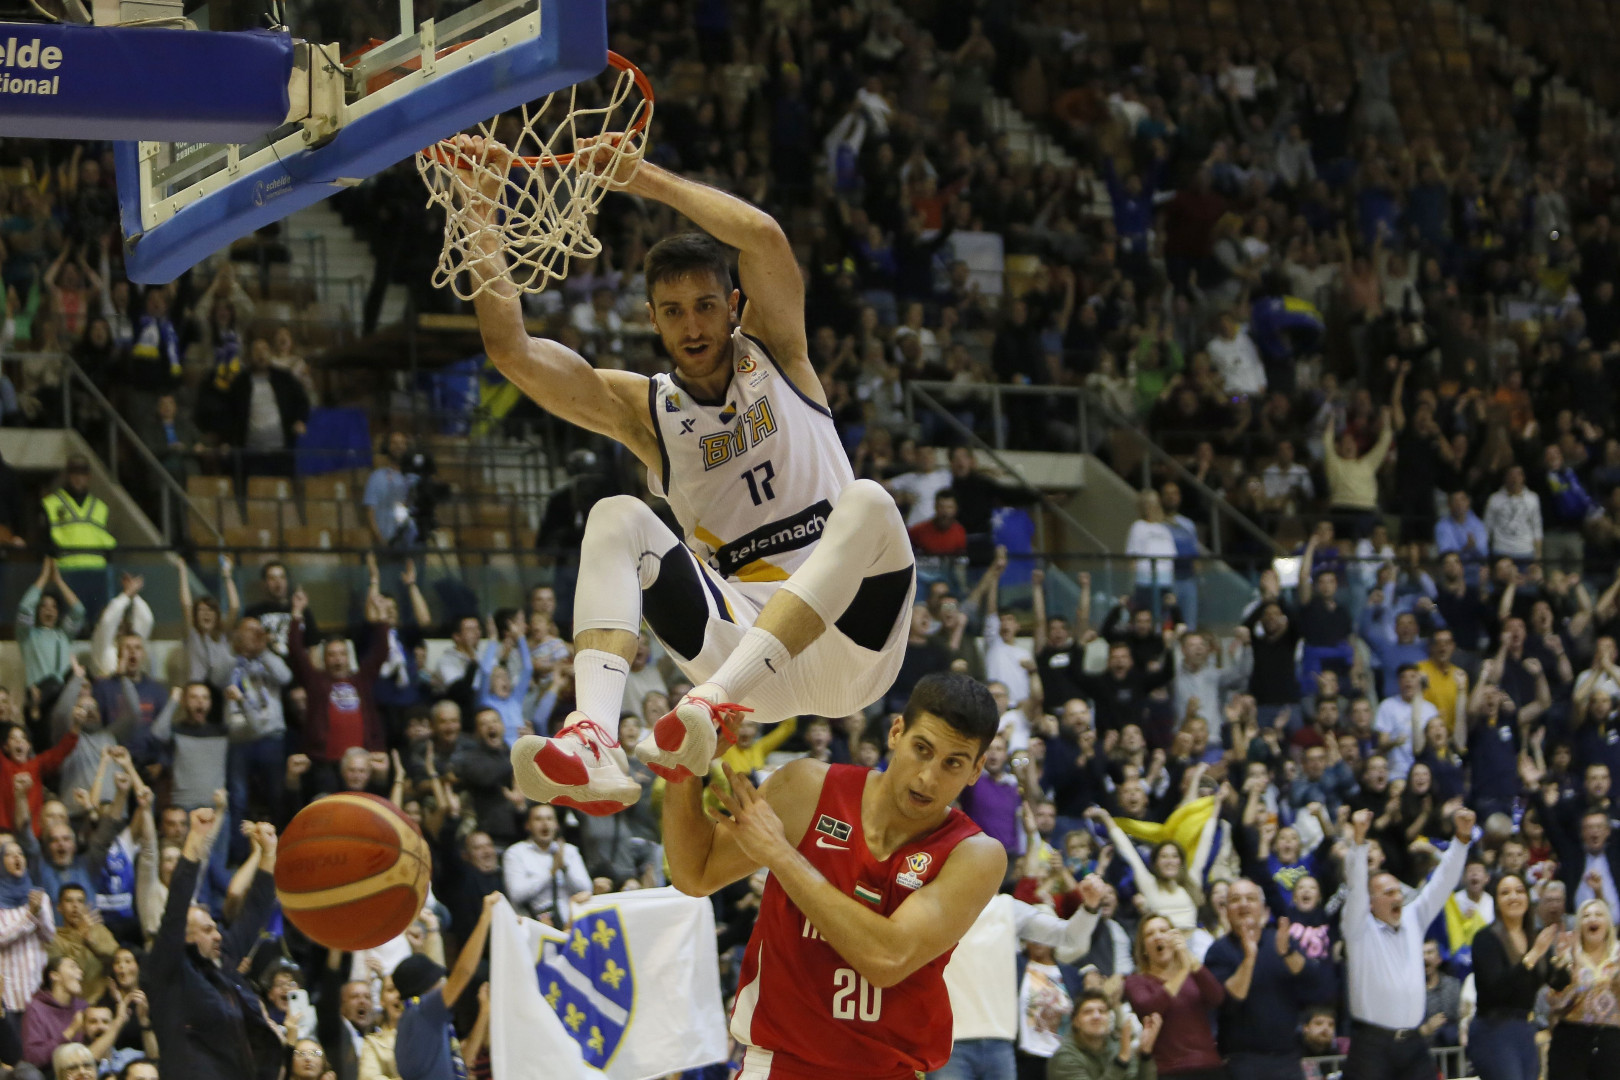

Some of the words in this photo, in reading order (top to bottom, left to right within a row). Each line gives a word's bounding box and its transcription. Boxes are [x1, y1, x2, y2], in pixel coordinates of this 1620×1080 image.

[0, 37, 63, 70] lde
[741, 460, 775, 506] 17
[729, 514, 827, 563] telemach
[833, 968, 882, 1022] 20
